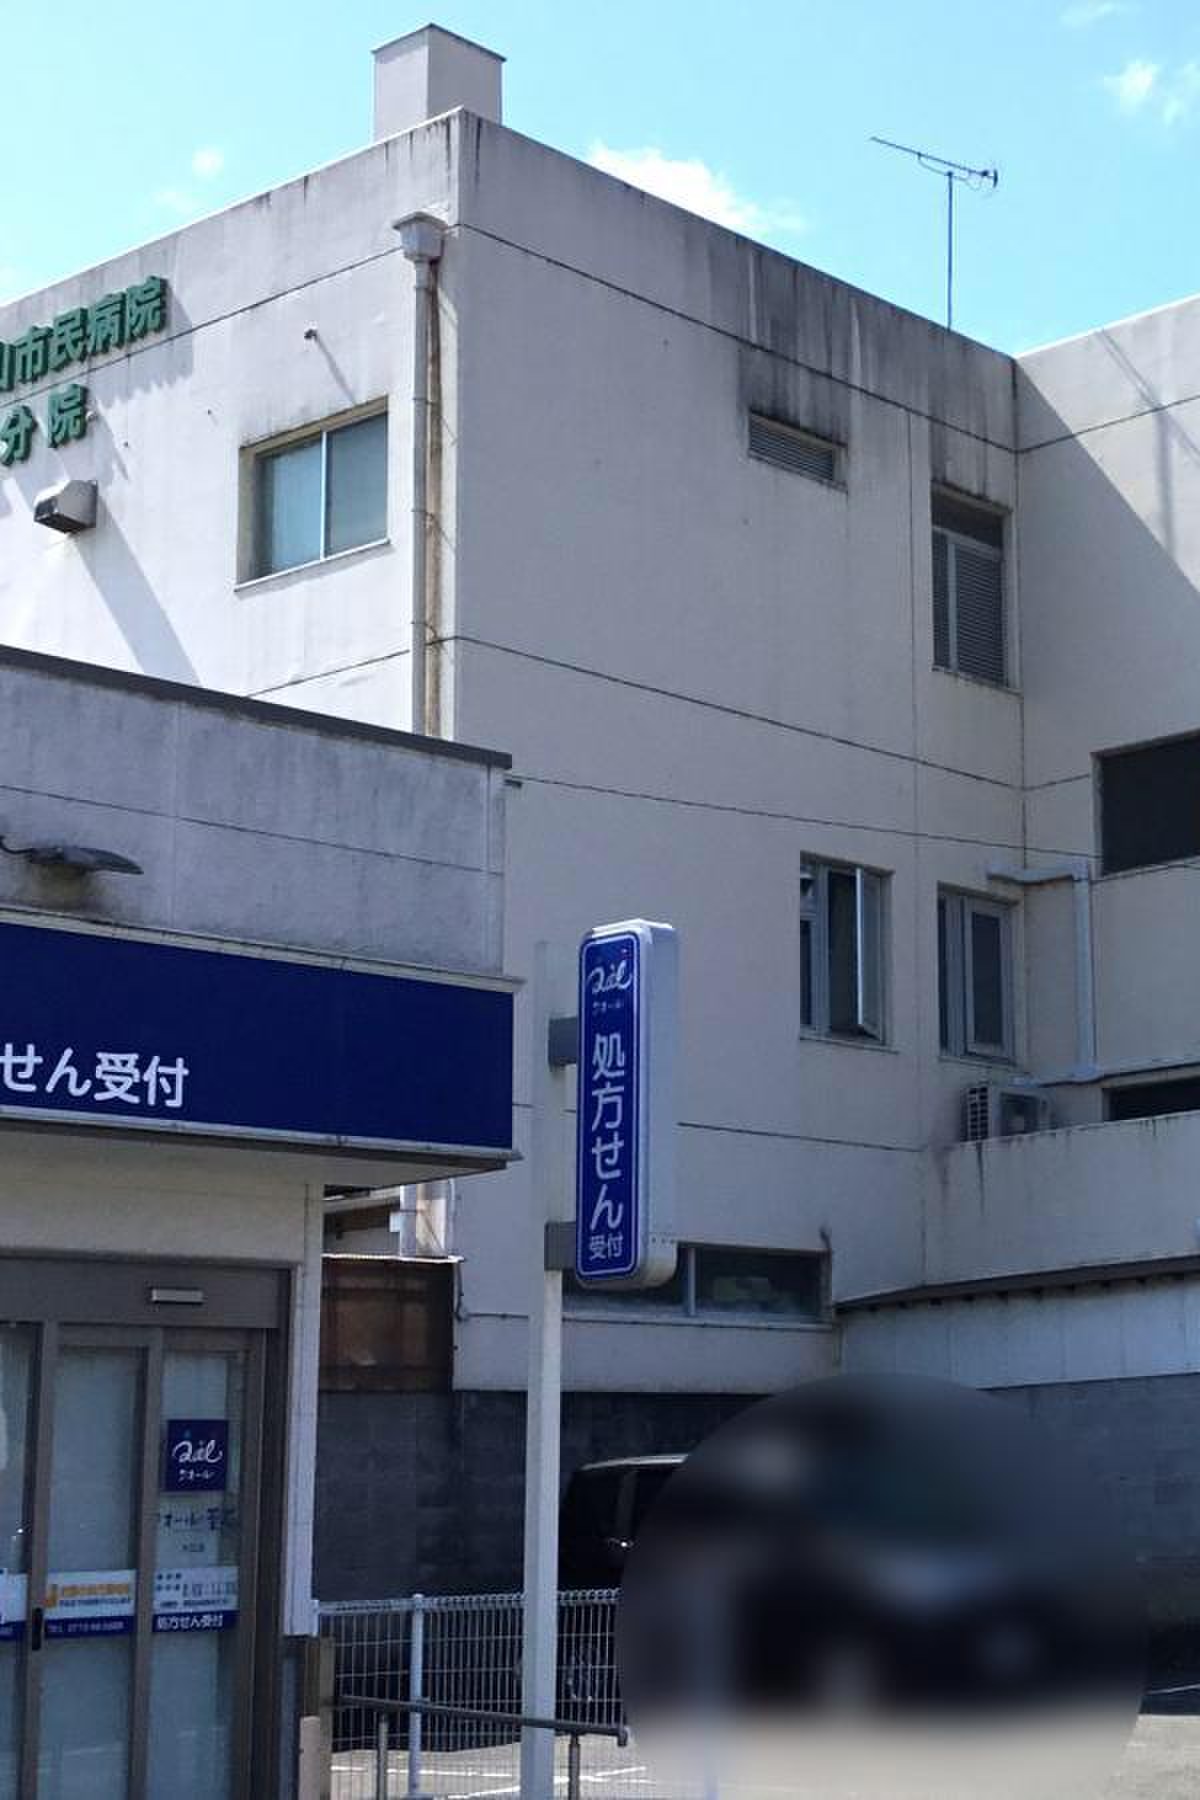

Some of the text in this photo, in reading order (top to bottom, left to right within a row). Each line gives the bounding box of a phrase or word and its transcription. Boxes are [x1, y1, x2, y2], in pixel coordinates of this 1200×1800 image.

[0, 1043, 190, 1108] せん受付
[591, 1033, 625, 1231] 処方せん
[589, 1231, 624, 1261] 受付
